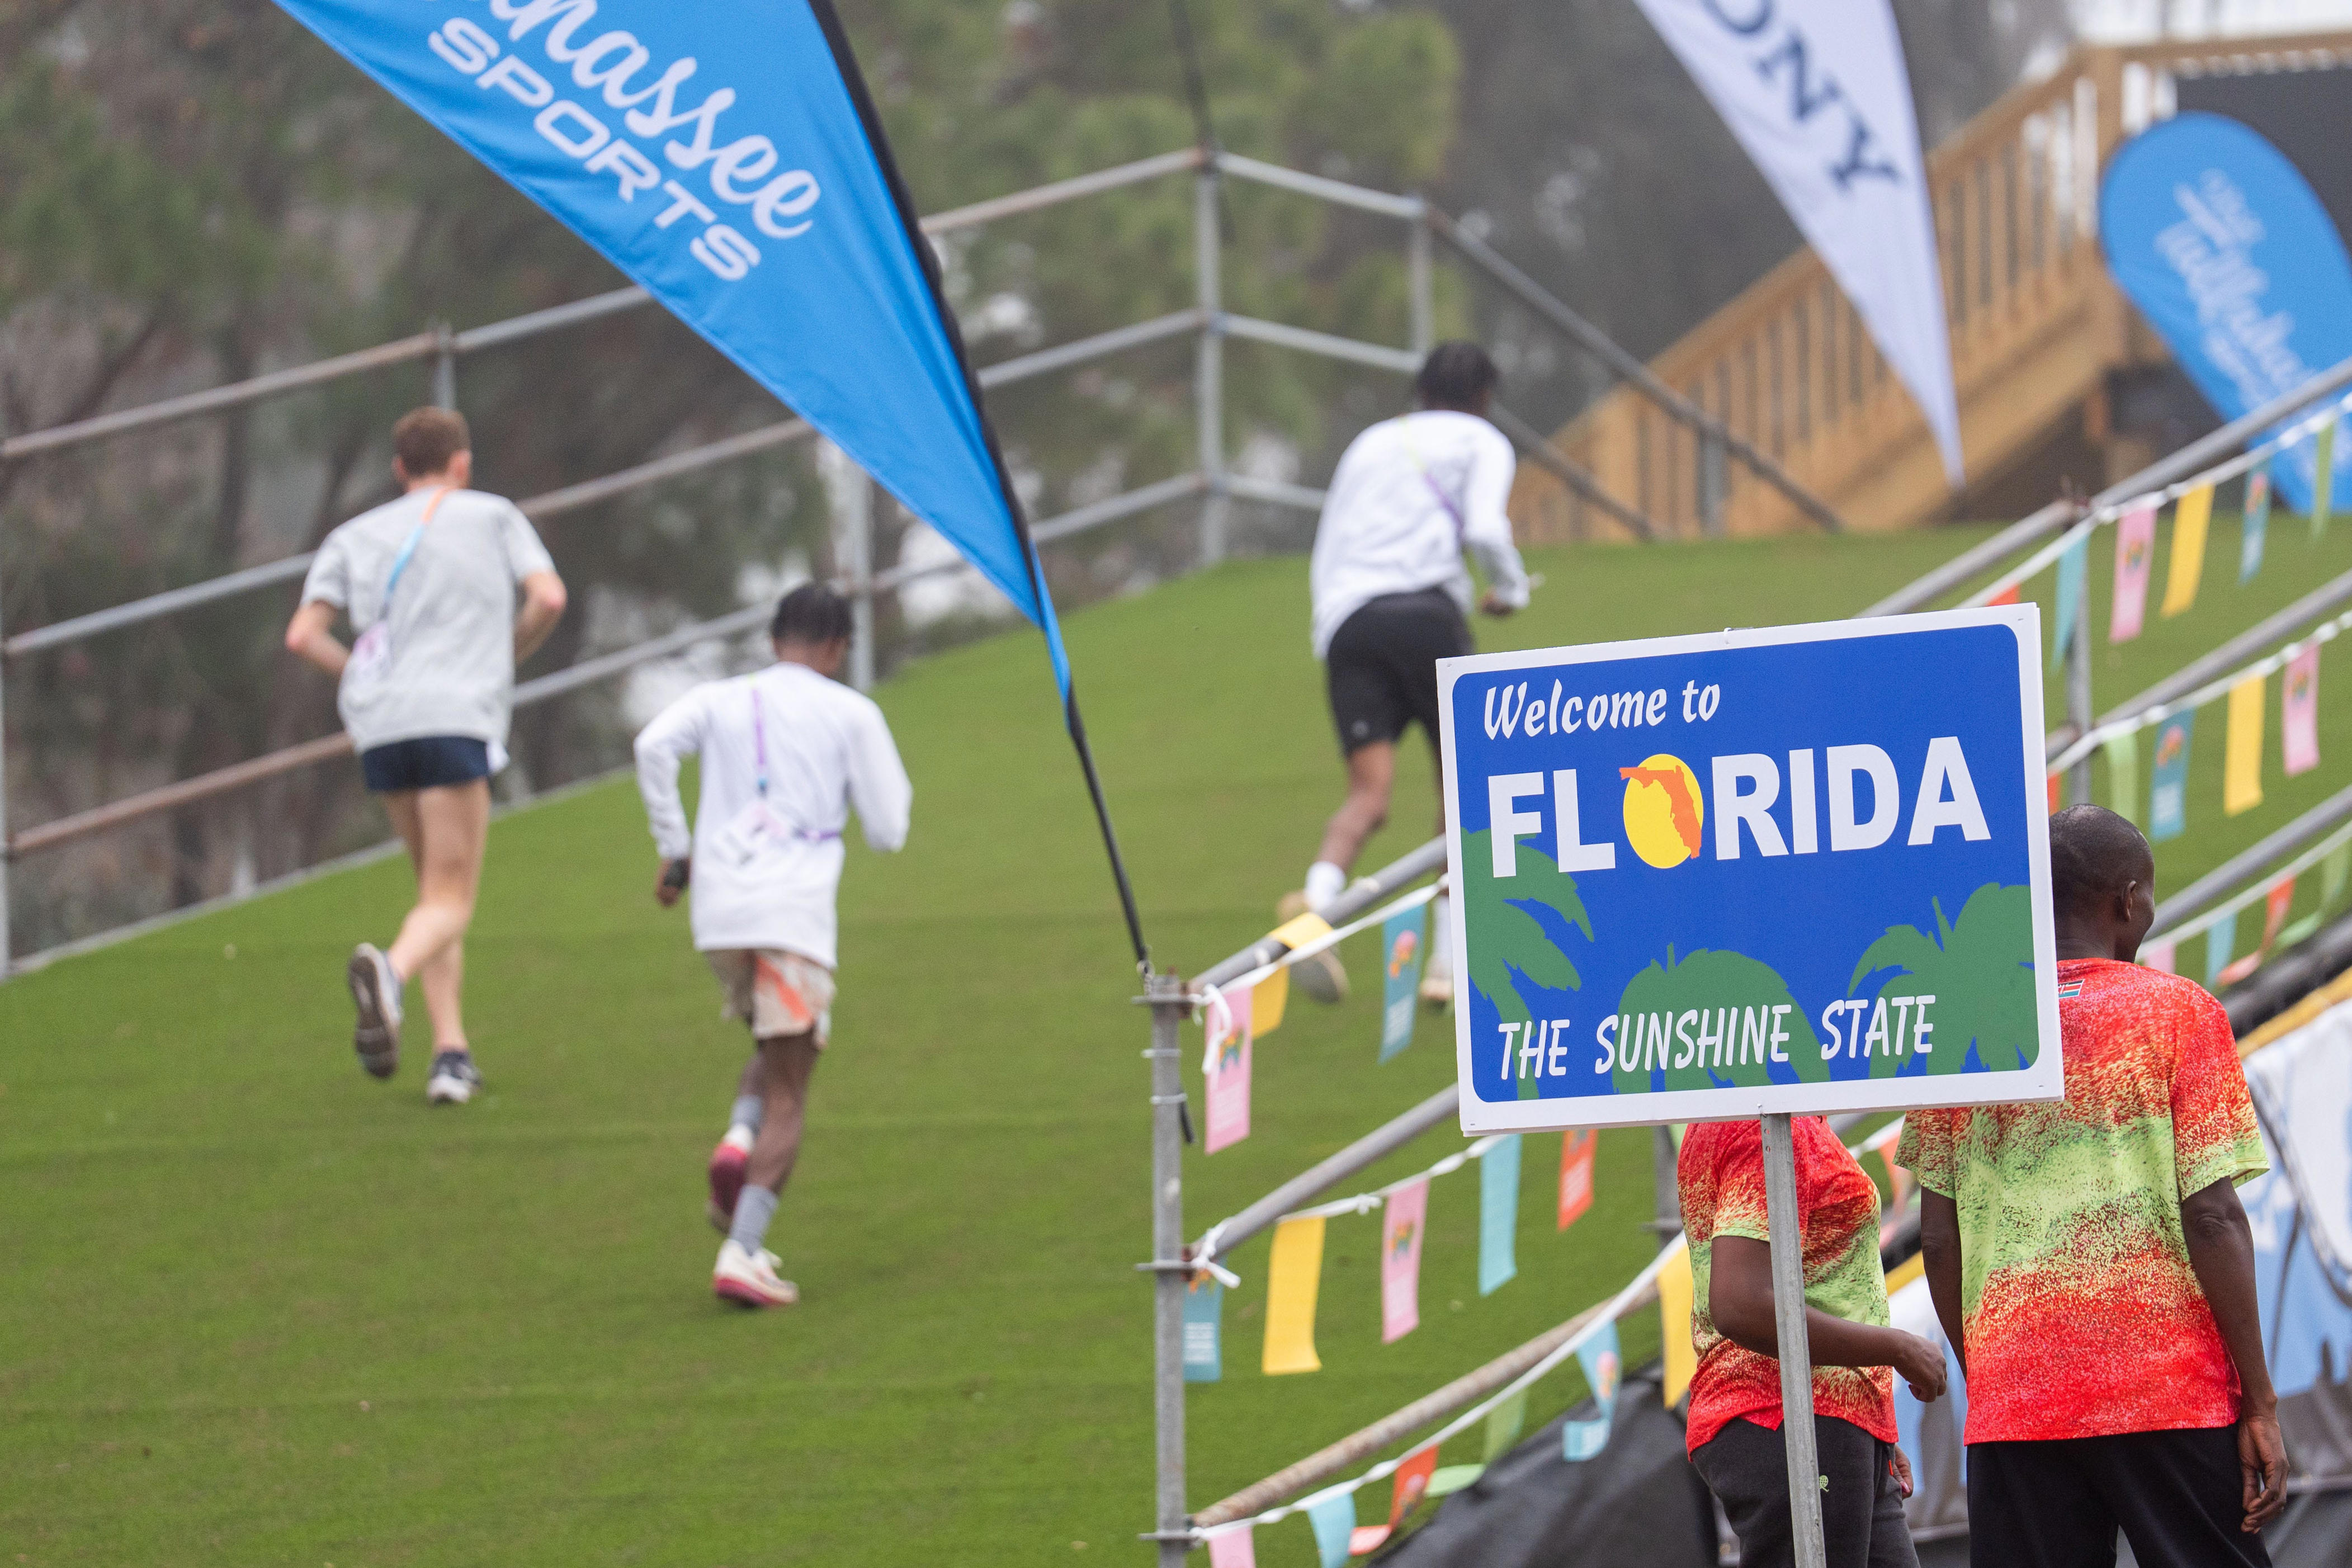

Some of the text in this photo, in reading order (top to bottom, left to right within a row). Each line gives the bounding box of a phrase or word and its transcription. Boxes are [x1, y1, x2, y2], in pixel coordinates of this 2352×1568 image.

[428, 17, 762, 281] SPORTS
[1484, 678, 1720, 740] Welcome to
[1487, 736, 1991, 878] FLORIDA
[1498, 995, 1936, 1080] THE SUNSHINE STATE
